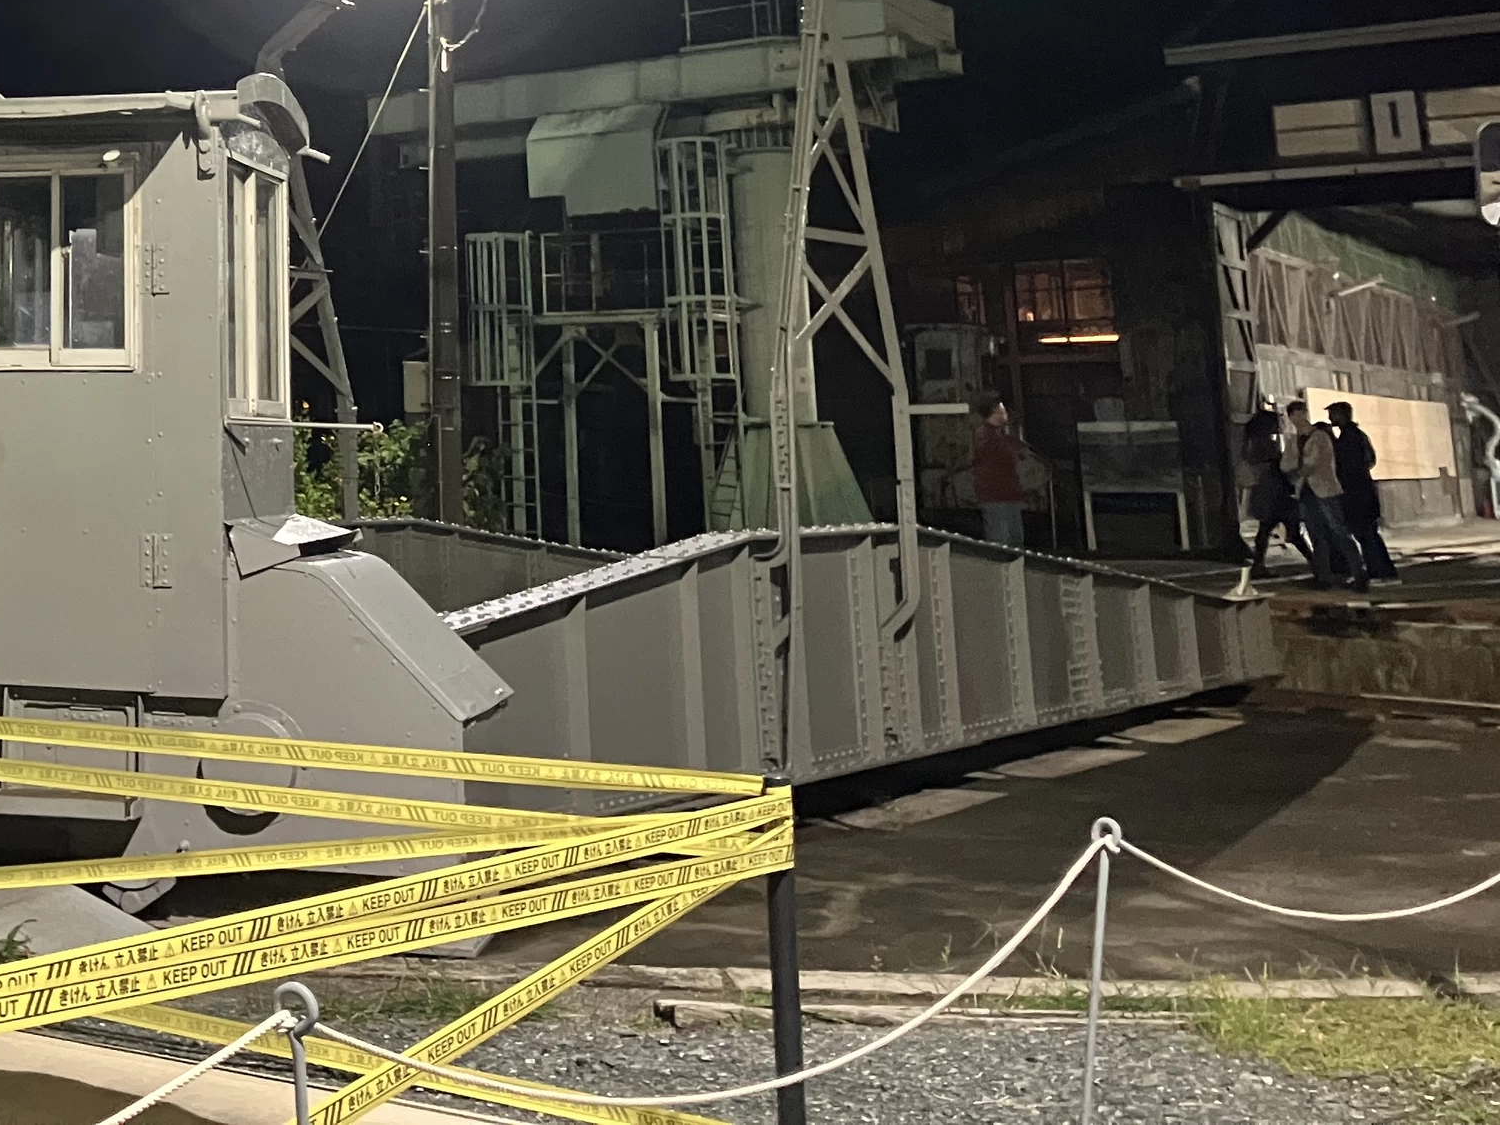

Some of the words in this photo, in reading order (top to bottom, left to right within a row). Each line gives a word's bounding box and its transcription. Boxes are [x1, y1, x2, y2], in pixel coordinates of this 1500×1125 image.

[58, 985, 90, 1006] きけん
[95, 975, 140, 999] 立入禁止
[163, 965, 196, 986] KEEP
[201, 959, 227, 978] OUT
[260, 947, 286, 967] きけん
[290, 939, 328, 961] 立入禁止
[346, 930, 375, 949] KEEP
[378, 926, 399, 943] OUT
[502, 901, 525, 918] KEEP
[528, 896, 547, 913] OUT
[634, 875, 655, 890] KEEP
[658, 871, 673, 885] OUT
[114, 943, 158, 969] 立入禁止
[180, 932, 214, 953] KEEP
[218, 925, 242, 945] OUT
[306, 902, 344, 925] 立入禁止
[362, 893, 390, 911] KEEP
[393, 887, 414, 904] OUT
[515, 858, 538, 876] KEEP
[541, 853, 559, 869] OUT
[645, 828, 666, 844] KEEP
[667, 824, 684, 839] OUT
[348, 1090, 373, 1111] きけん
[427, 1037, 454, 1062] KEEP
[457, 1022, 477, 1044] OUT
[569, 952, 593, 976] KEEP
[594, 940, 612, 959] OUT
